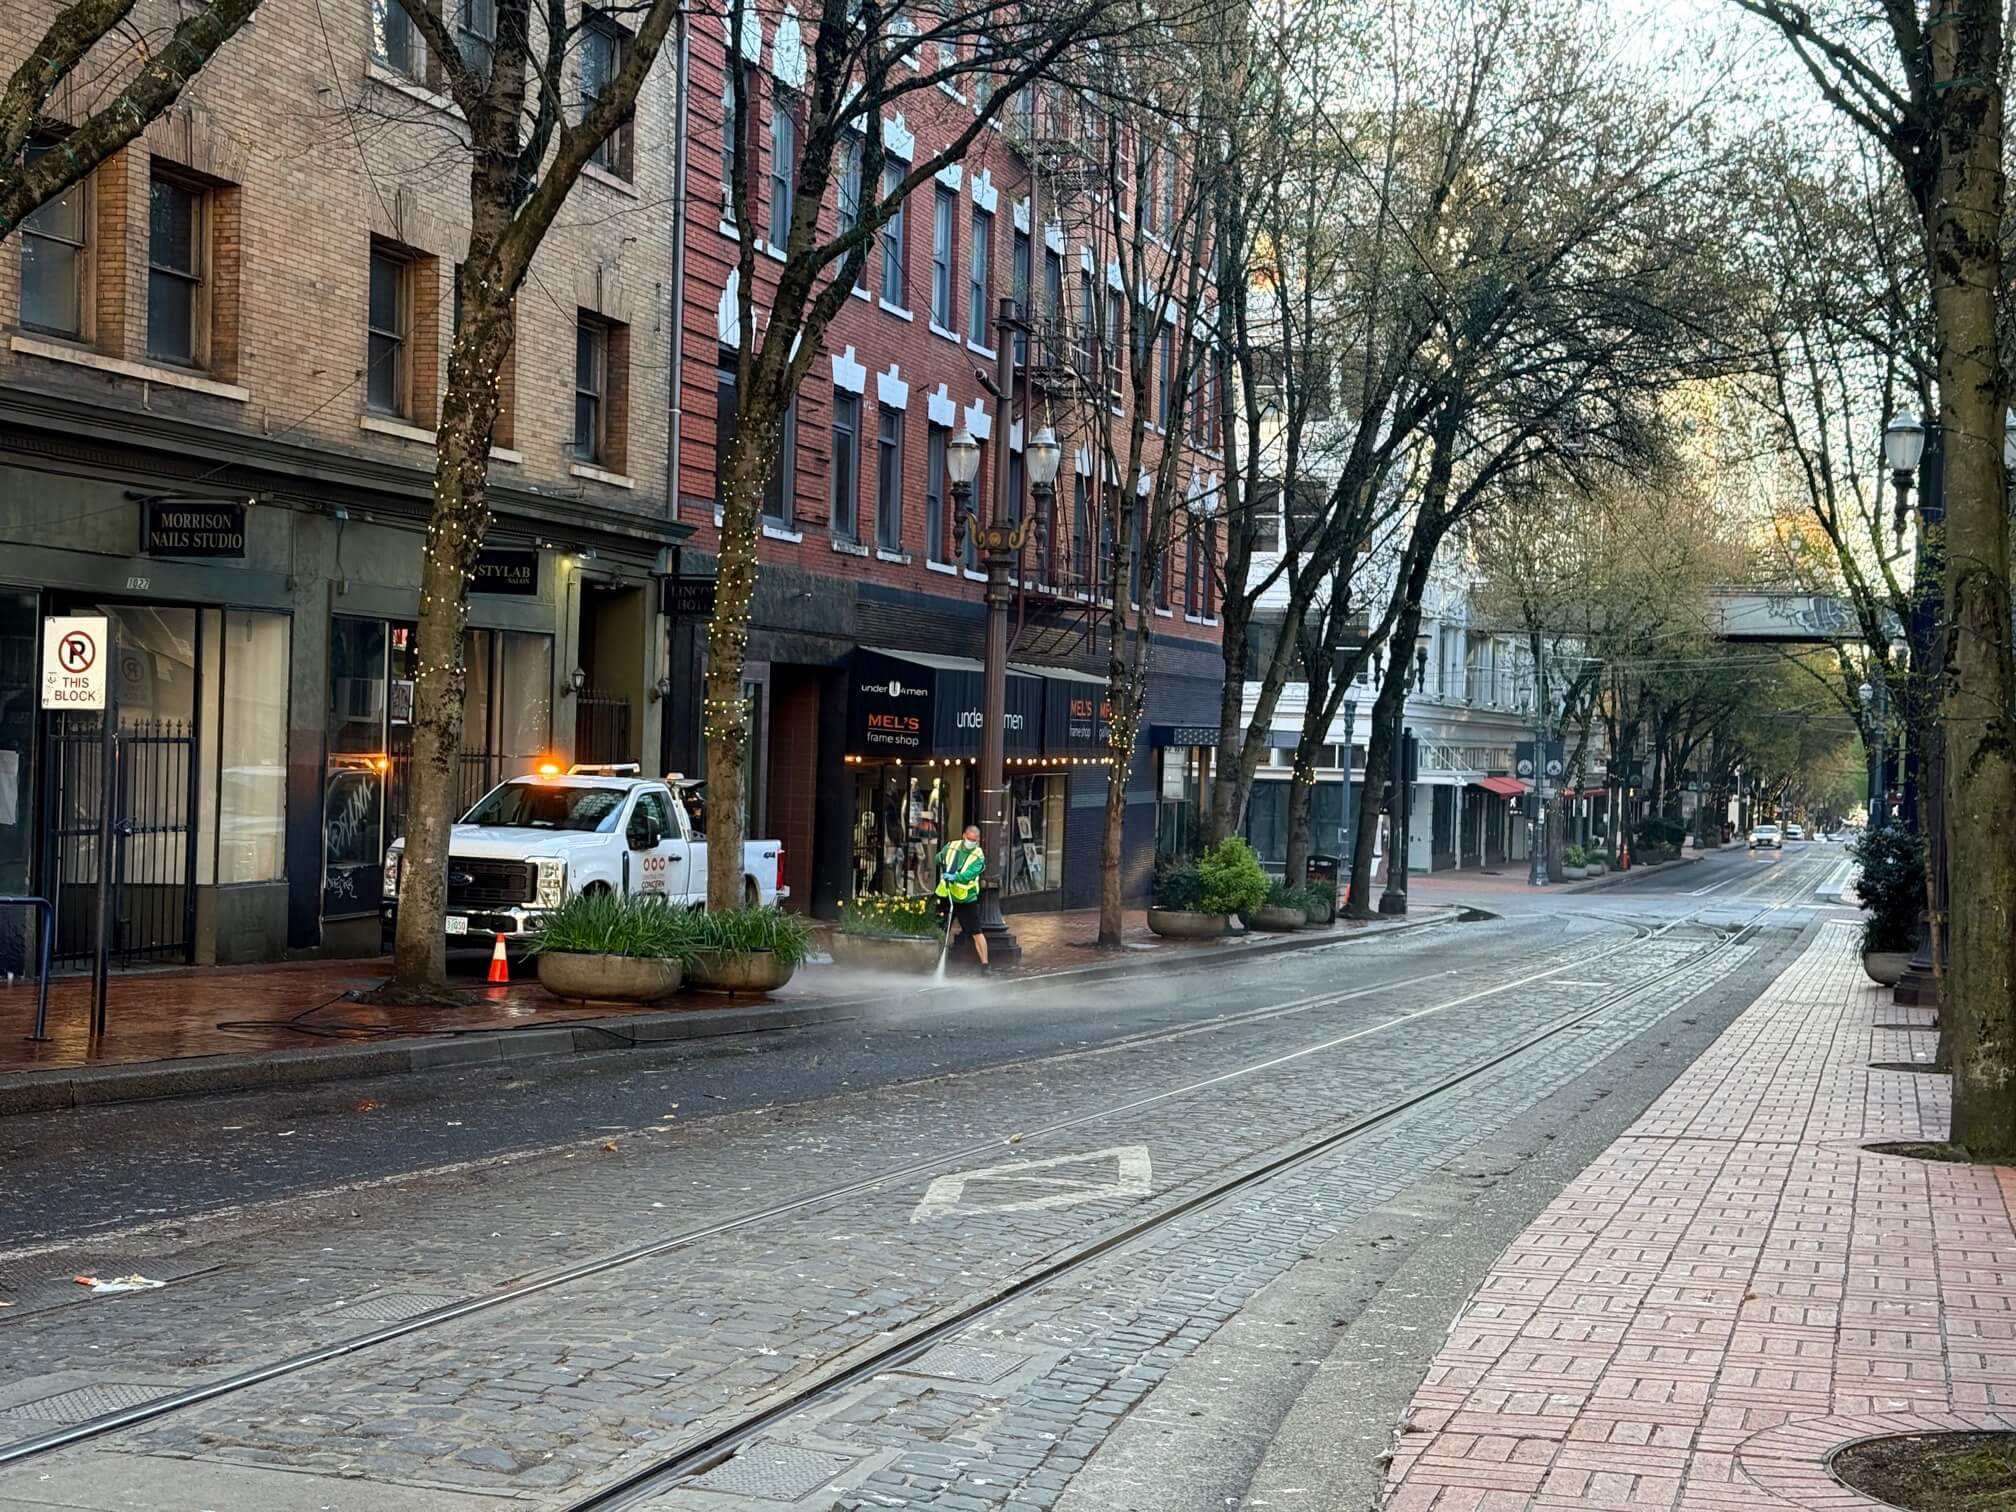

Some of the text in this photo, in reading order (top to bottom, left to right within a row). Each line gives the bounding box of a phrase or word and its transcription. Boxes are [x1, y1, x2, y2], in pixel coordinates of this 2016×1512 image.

[161, 512, 232, 529] MORRISON
[151, 532, 242, 549] NAILS STUDIO
[671, 585, 713, 598] LINCO
[62, 677, 90, 689] THIS
[54, 690, 96, 702] BLOCK
[868, 713, 920, 731] MEL'S
[1003, 713, 1024, 731] men
[867, 732, 920, 748] frame shop
